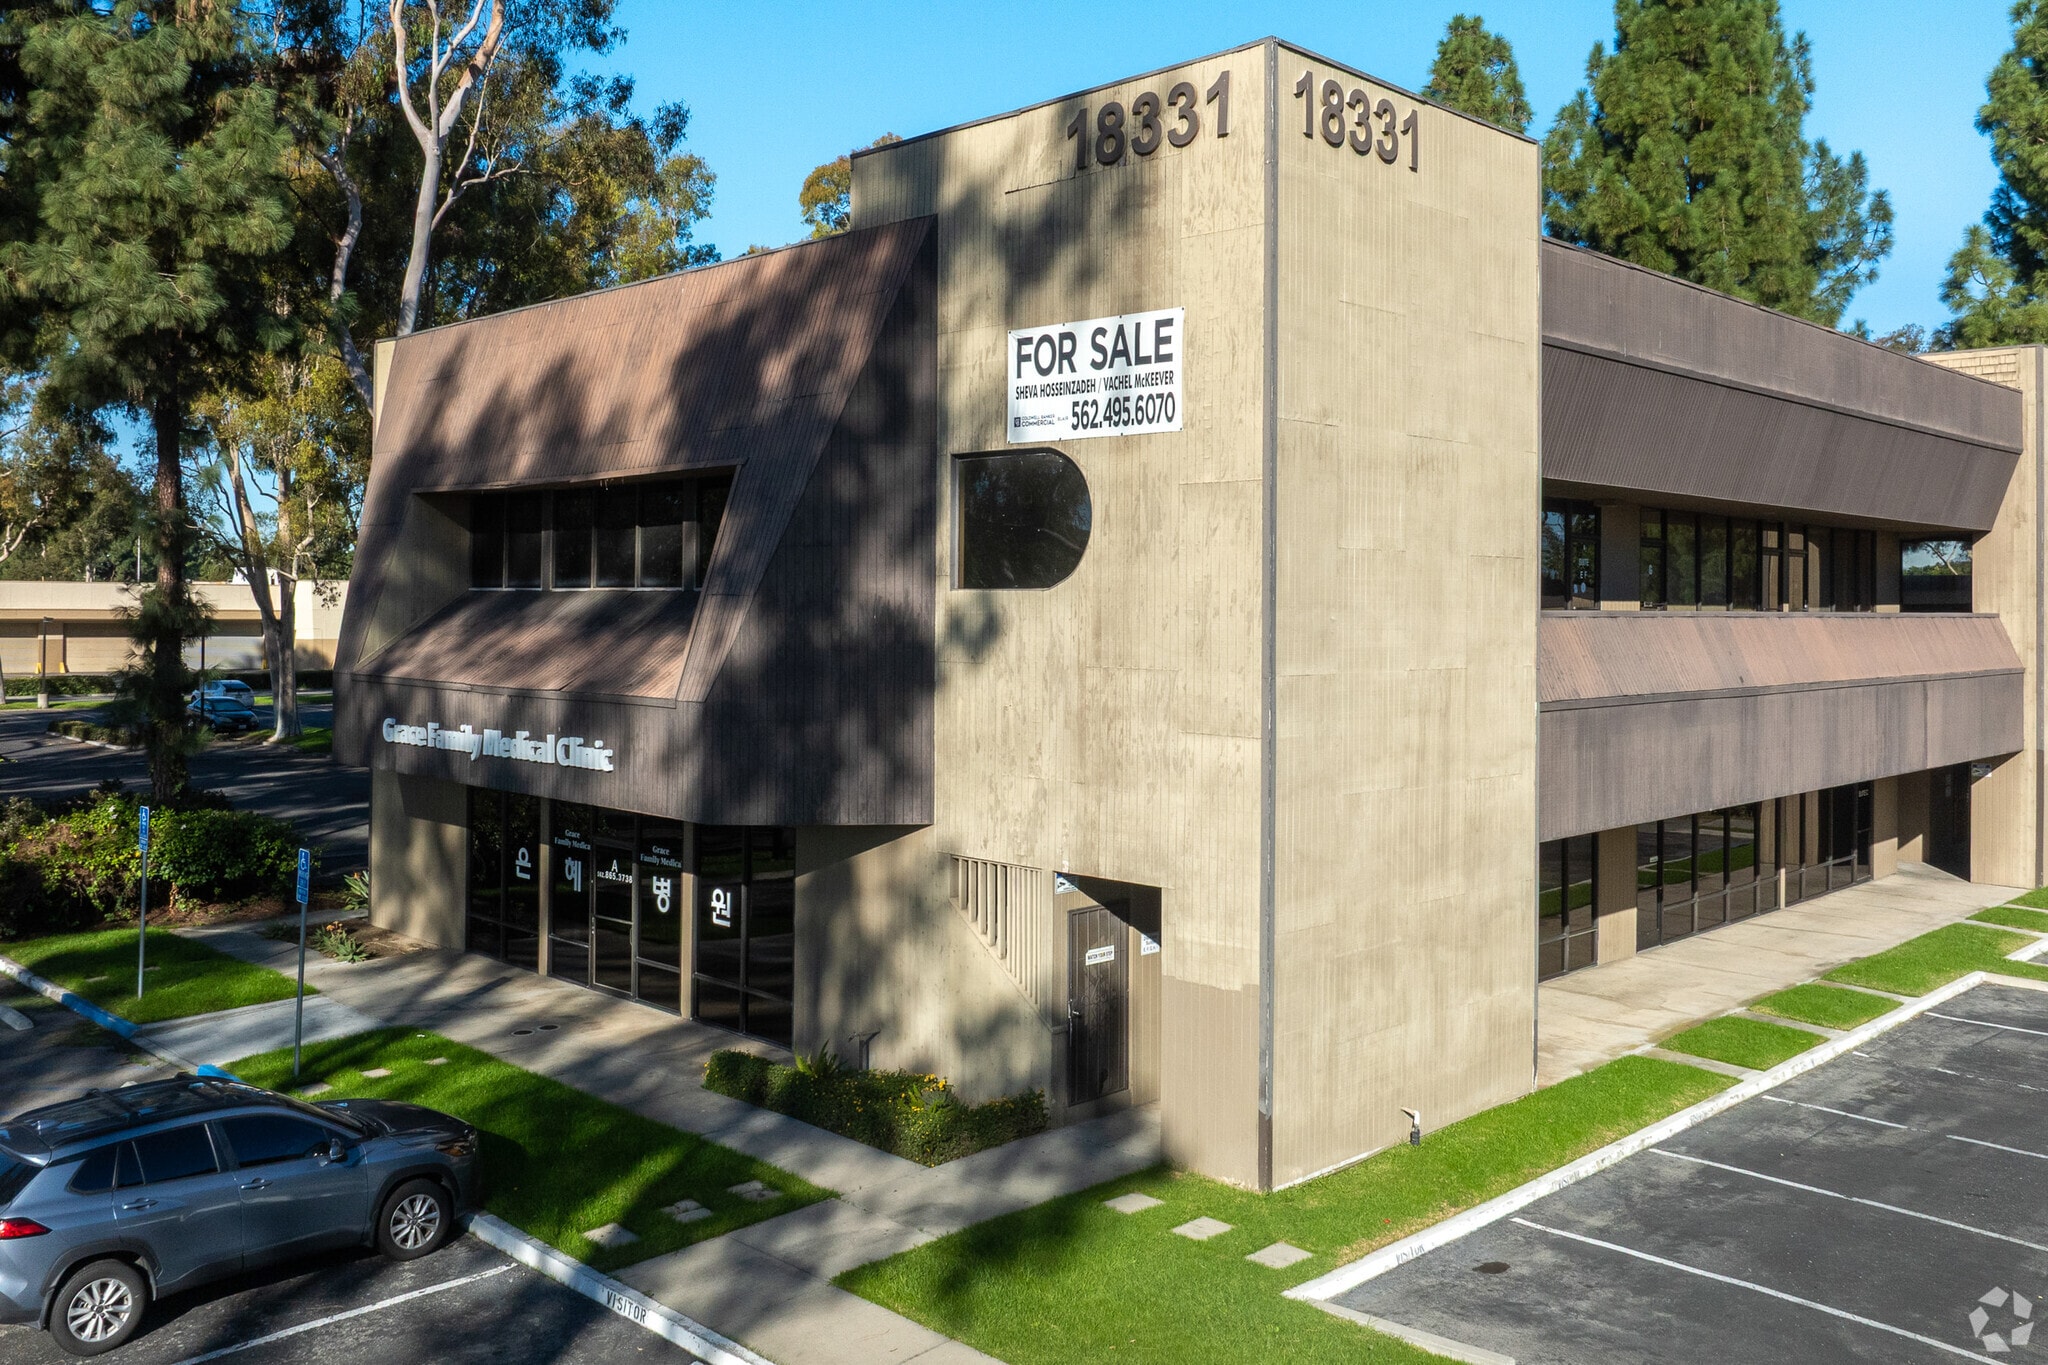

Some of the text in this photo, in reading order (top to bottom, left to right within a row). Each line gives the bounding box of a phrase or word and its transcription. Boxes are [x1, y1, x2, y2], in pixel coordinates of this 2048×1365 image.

[1067, 70, 1231, 170] 18331
[1294, 70, 1418, 172] 18331
[1016, 318, 1174, 379] FOR SALE
[1016, 385, 1038, 400] SHEVA
[1040, 378, 1096, 398] HOSSEINZADEH
[1104, 374, 1132, 391] VACHEL
[1134, 370, 1174, 388] McKEEVER
[1022, 419, 1055, 427] COMMERCIAL
[1071, 392, 1176, 431] 562.495.6070
[382, 717, 614, 772] Grace Family Medical Clinic
[555, 837, 571, 849] Family
[565, 829, 580, 839] Grace
[652, 845, 670, 855] Grace
[611, 859, 618, 872] A
[640, 853, 659, 866] Family
[652, 875, 671, 913] 병
[606, 1290, 647, 1324] VISITOR
